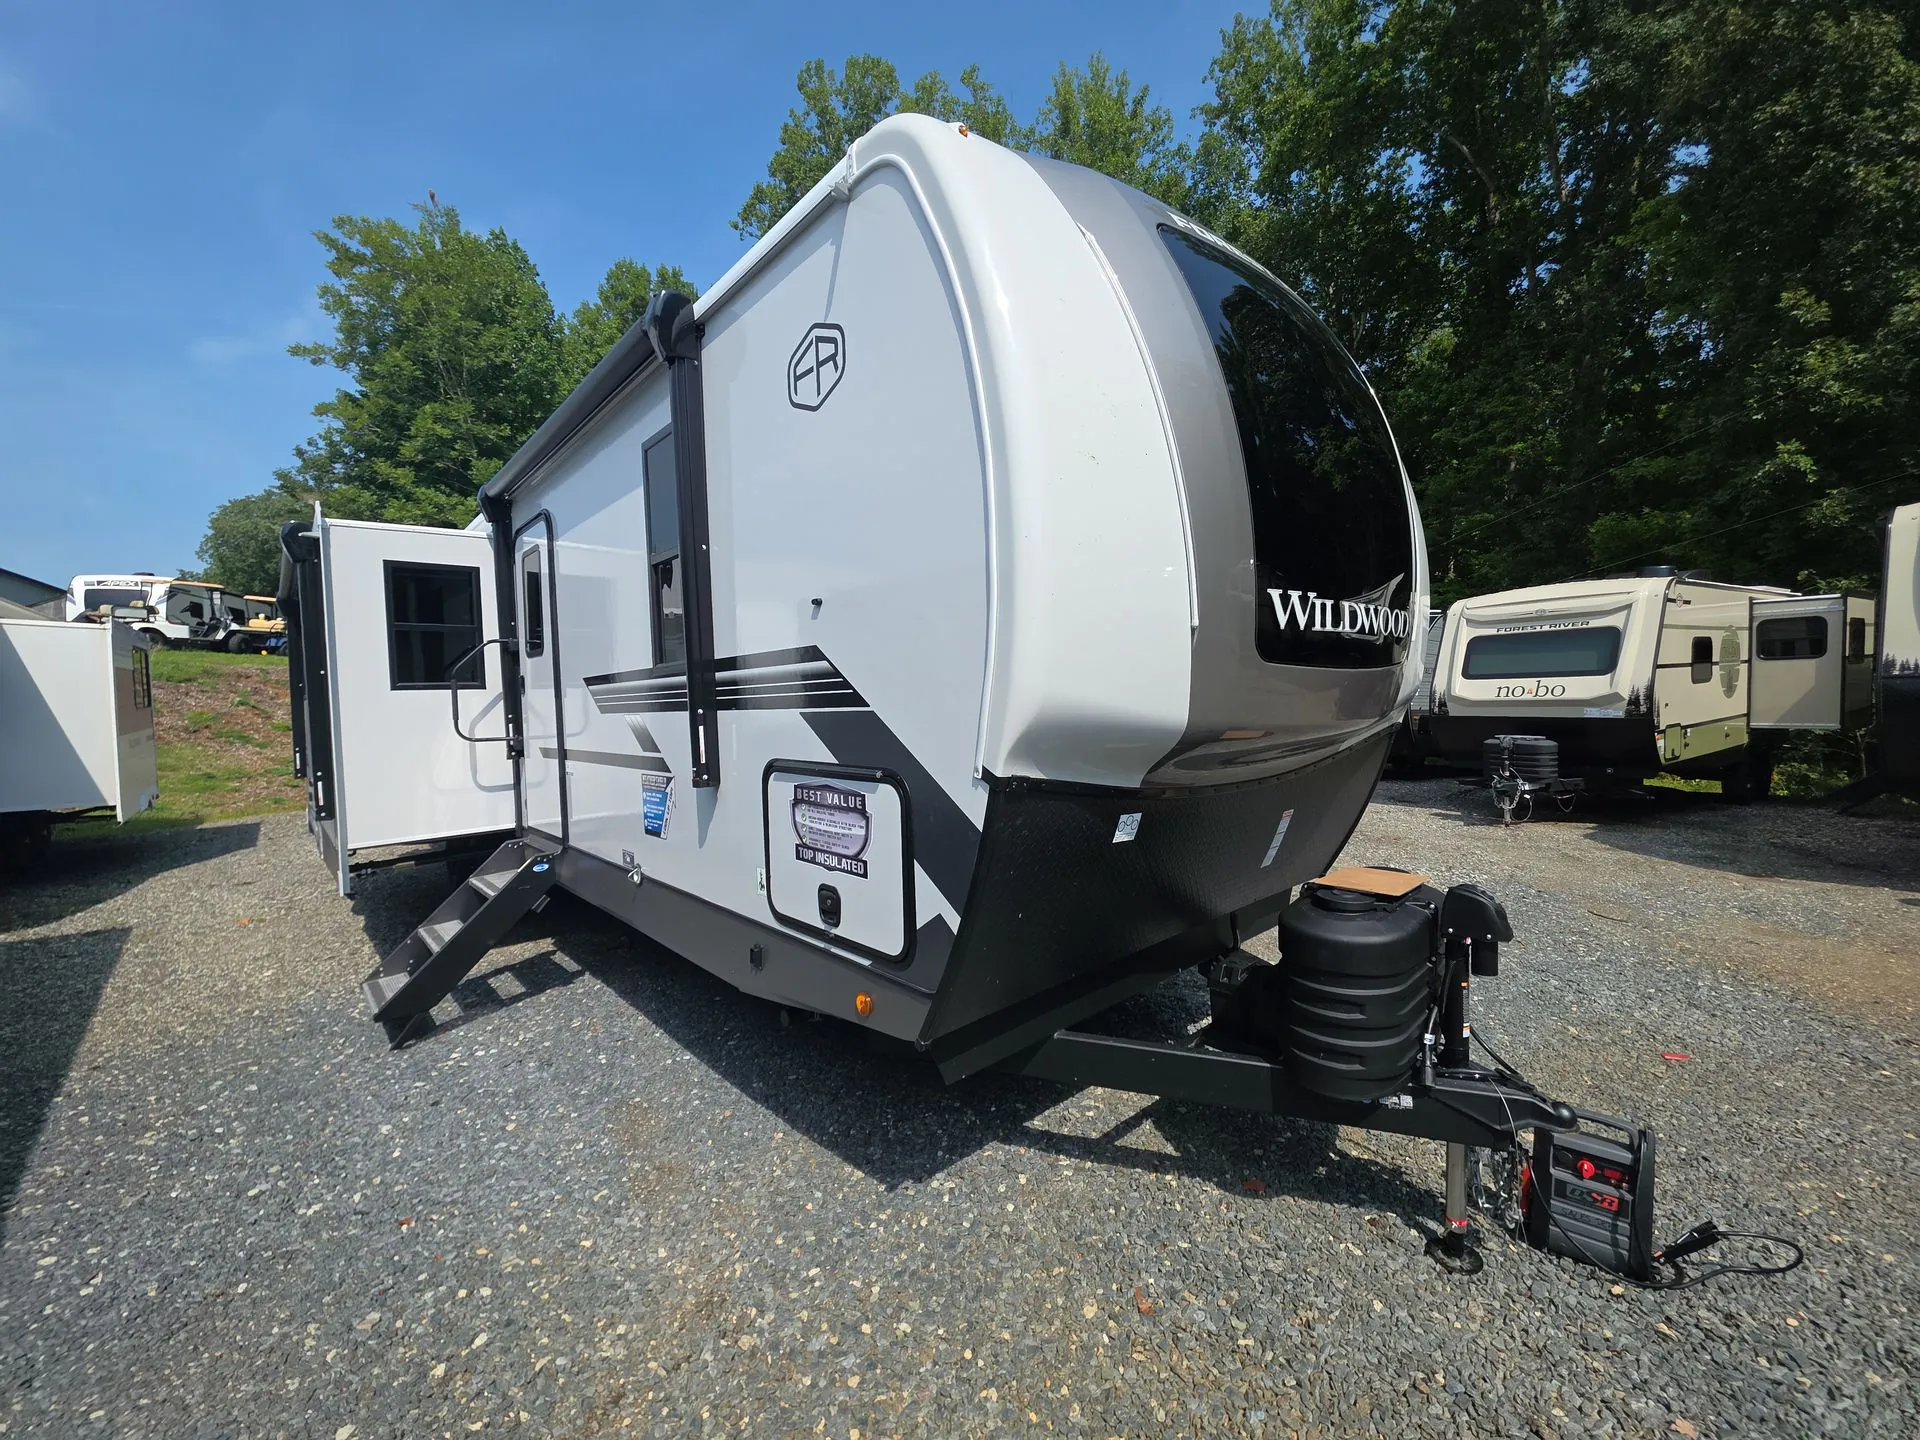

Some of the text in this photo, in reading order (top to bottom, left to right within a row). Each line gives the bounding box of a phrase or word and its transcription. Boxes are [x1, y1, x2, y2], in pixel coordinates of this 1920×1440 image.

[1266, 588, 1410, 638] WILDWOOD
[1496, 620, 1590, 633] FOREST RIVER
[796, 787, 863, 809] BEST VALUE
[798, 846, 865, 875] TOP INSULATED
